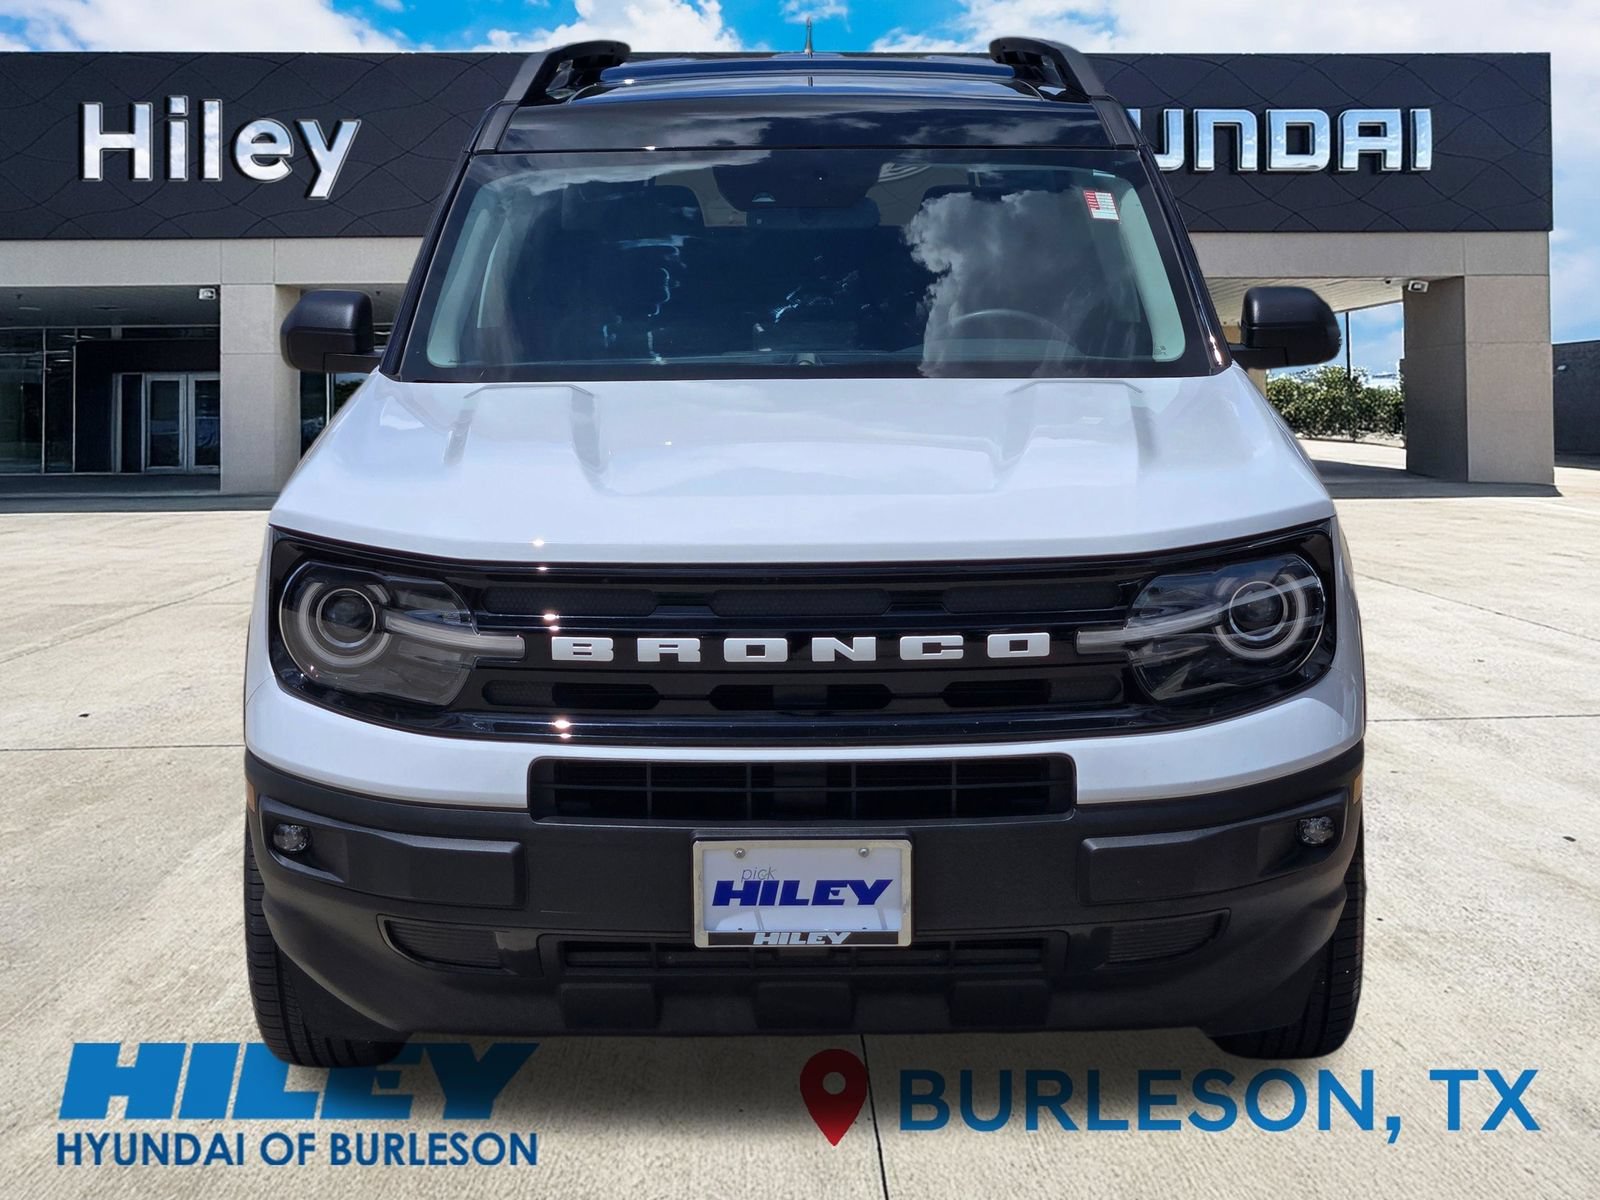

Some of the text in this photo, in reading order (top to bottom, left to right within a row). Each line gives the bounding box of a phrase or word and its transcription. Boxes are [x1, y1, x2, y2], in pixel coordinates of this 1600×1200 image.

[80, 95, 363, 200] Hiley
[550, 632, 1051, 664] BRONCO
[741, 866, 776, 882] pick
[712, 879, 894, 907] HILEY
[752, 931, 852, 946] HILEY
